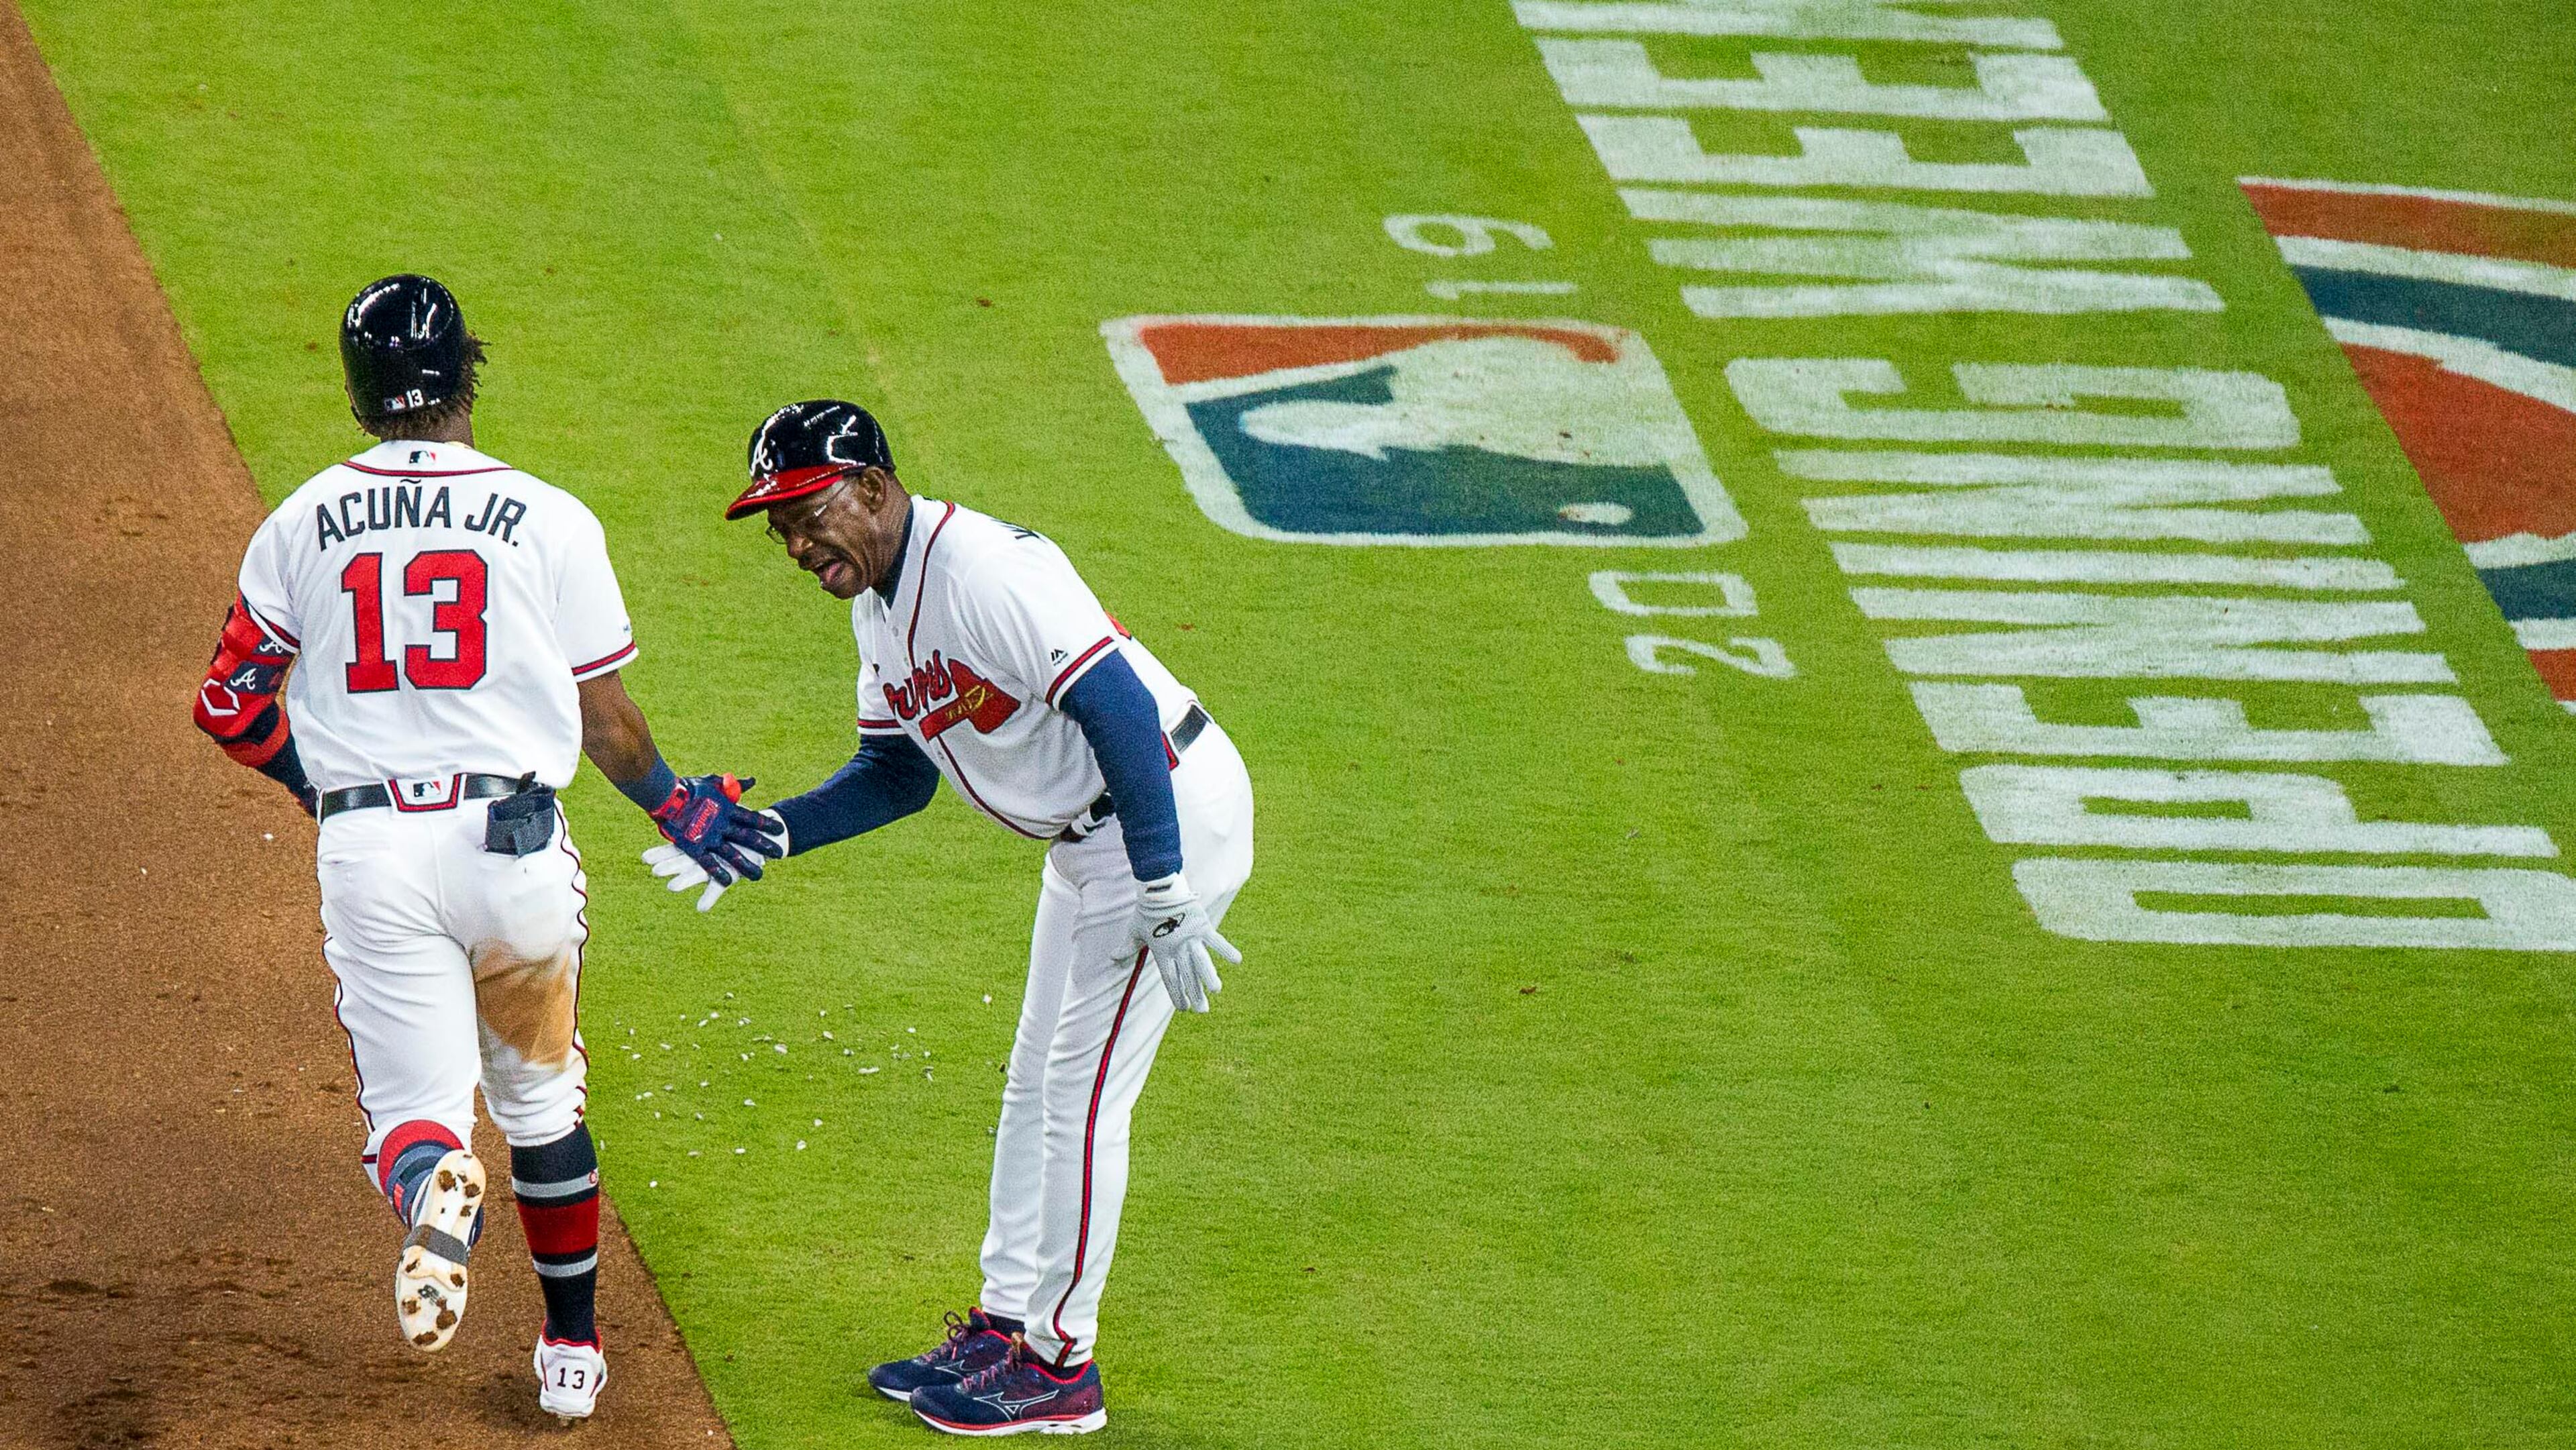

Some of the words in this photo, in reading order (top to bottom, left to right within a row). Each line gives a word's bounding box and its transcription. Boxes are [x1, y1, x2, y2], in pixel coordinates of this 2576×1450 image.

[1383, 213, 1577, 301] 19
[405, 389, 424, 408] 13
[317, 478, 451, 552] ACUÑA
[464, 493, 527, 547] JR.
[341, 549, 488, 694] 13
[1589, 570, 1799, 680] 20
[1724, 357, 2576, 951] OPENING
[557, 1367, 585, 1390] 13
